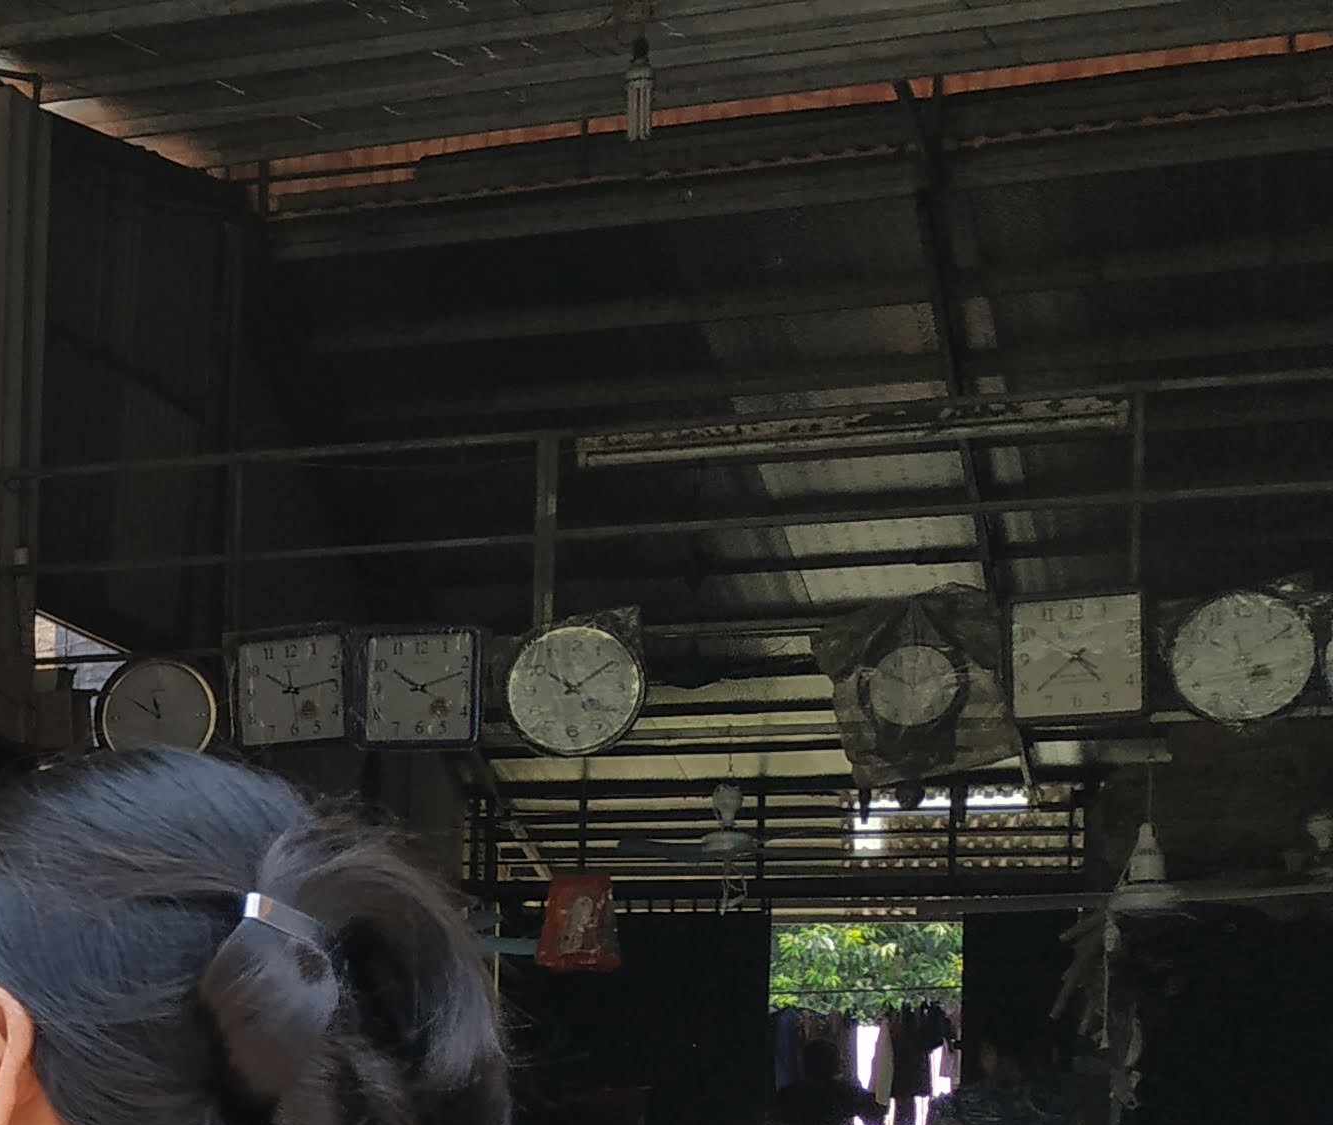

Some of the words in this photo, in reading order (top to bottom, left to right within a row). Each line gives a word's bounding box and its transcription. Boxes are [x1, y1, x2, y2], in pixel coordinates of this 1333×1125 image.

[263, 646, 274, 661] 11
[285, 644, 297, 659] 12
[309, 642, 317, 655] 1
[392, 641, 404, 655] 11
[412, 641, 429, 655] 12
[441, 641, 448, 654] 1
[330, 656, 338, 669] 2
[375, 659, 388, 672] 10
[290, 722, 299, 736] 6
[313, 720, 321, 734] 5
[415, 720, 424, 735] 6
[438, 720, 447, 734] 5
